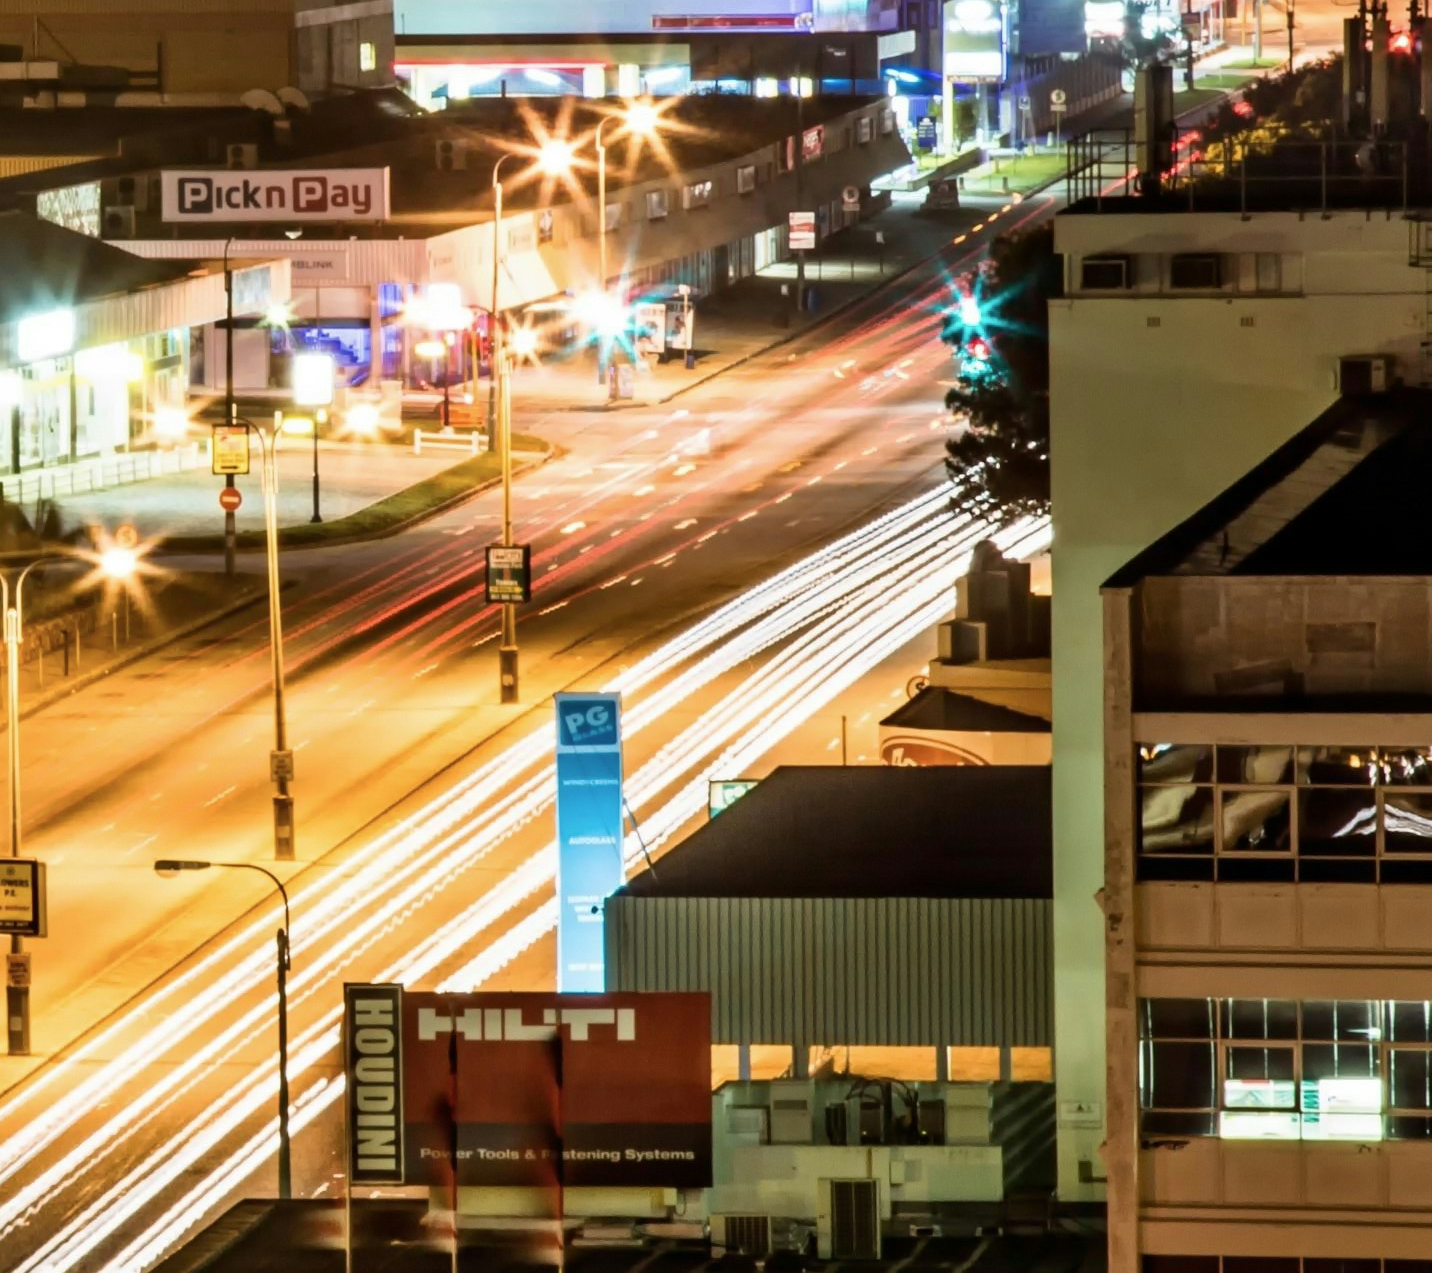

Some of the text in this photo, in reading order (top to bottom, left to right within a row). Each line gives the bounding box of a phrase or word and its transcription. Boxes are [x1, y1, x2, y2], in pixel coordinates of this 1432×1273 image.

[178, 176, 371, 214] Pick n Pay
[565, 705, 609, 735] PG
[418, 1008, 635, 1041] HILTI
[355, 998, 396, 1171] HOUDINI
[477, 1147, 519, 1160] Tools
[524, 1147, 535, 1160] &
[624, 1147, 695, 1162] Systems
